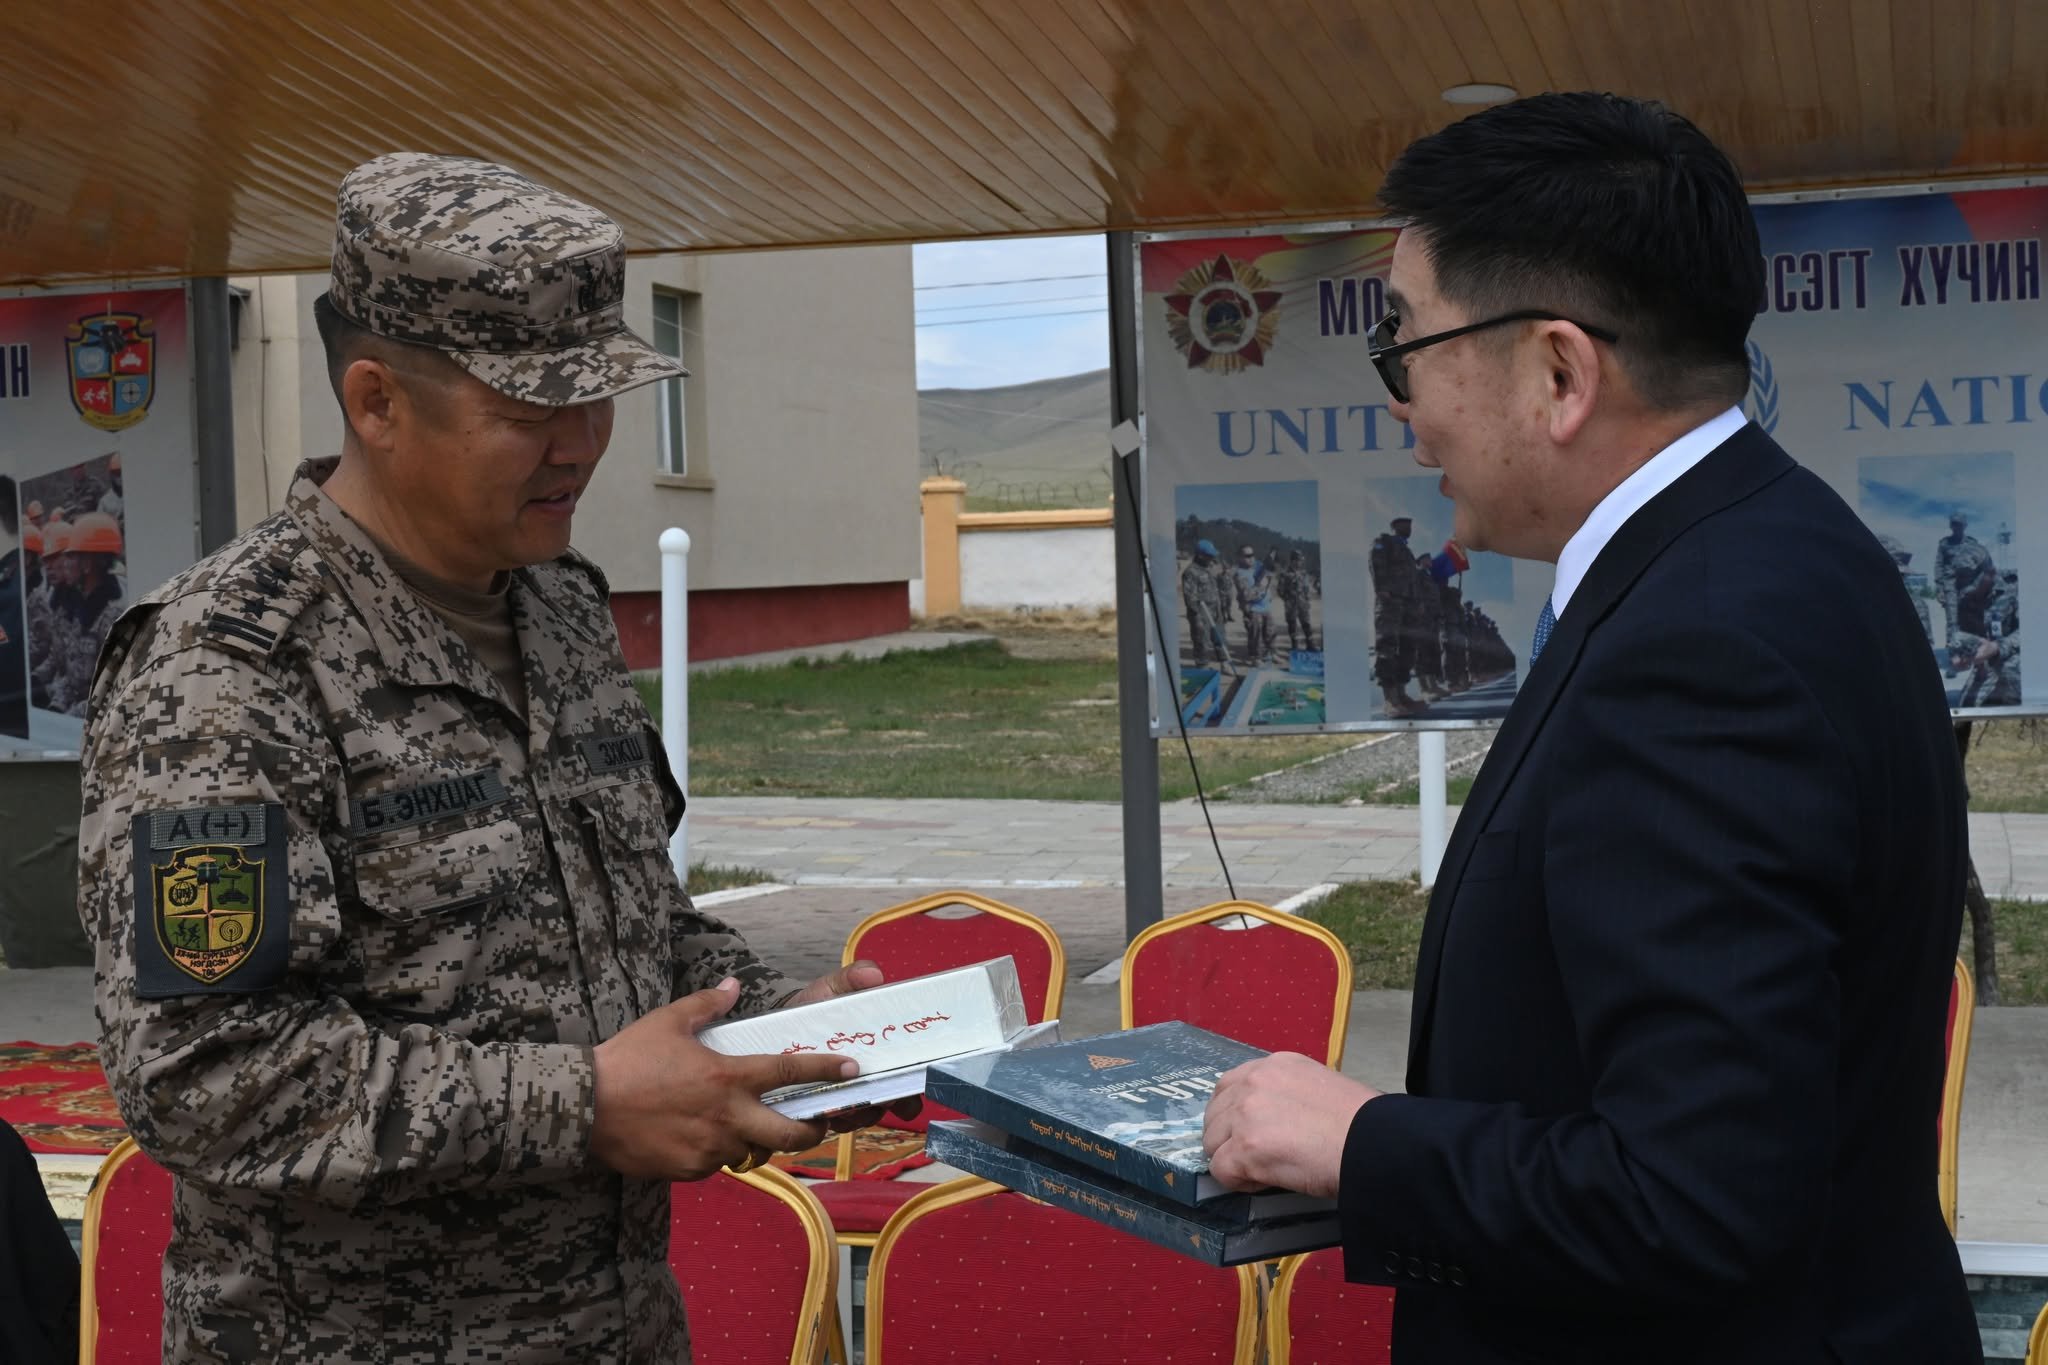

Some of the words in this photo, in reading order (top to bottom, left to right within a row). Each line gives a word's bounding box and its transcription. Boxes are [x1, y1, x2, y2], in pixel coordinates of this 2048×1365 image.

[1318, 277, 1384, 336] МО
[1900, 240, 2040, 306] ХҮЧИН
[1843, 374, 2048, 431] NATI
[1107, 1072, 1223, 1103] ТУУ
